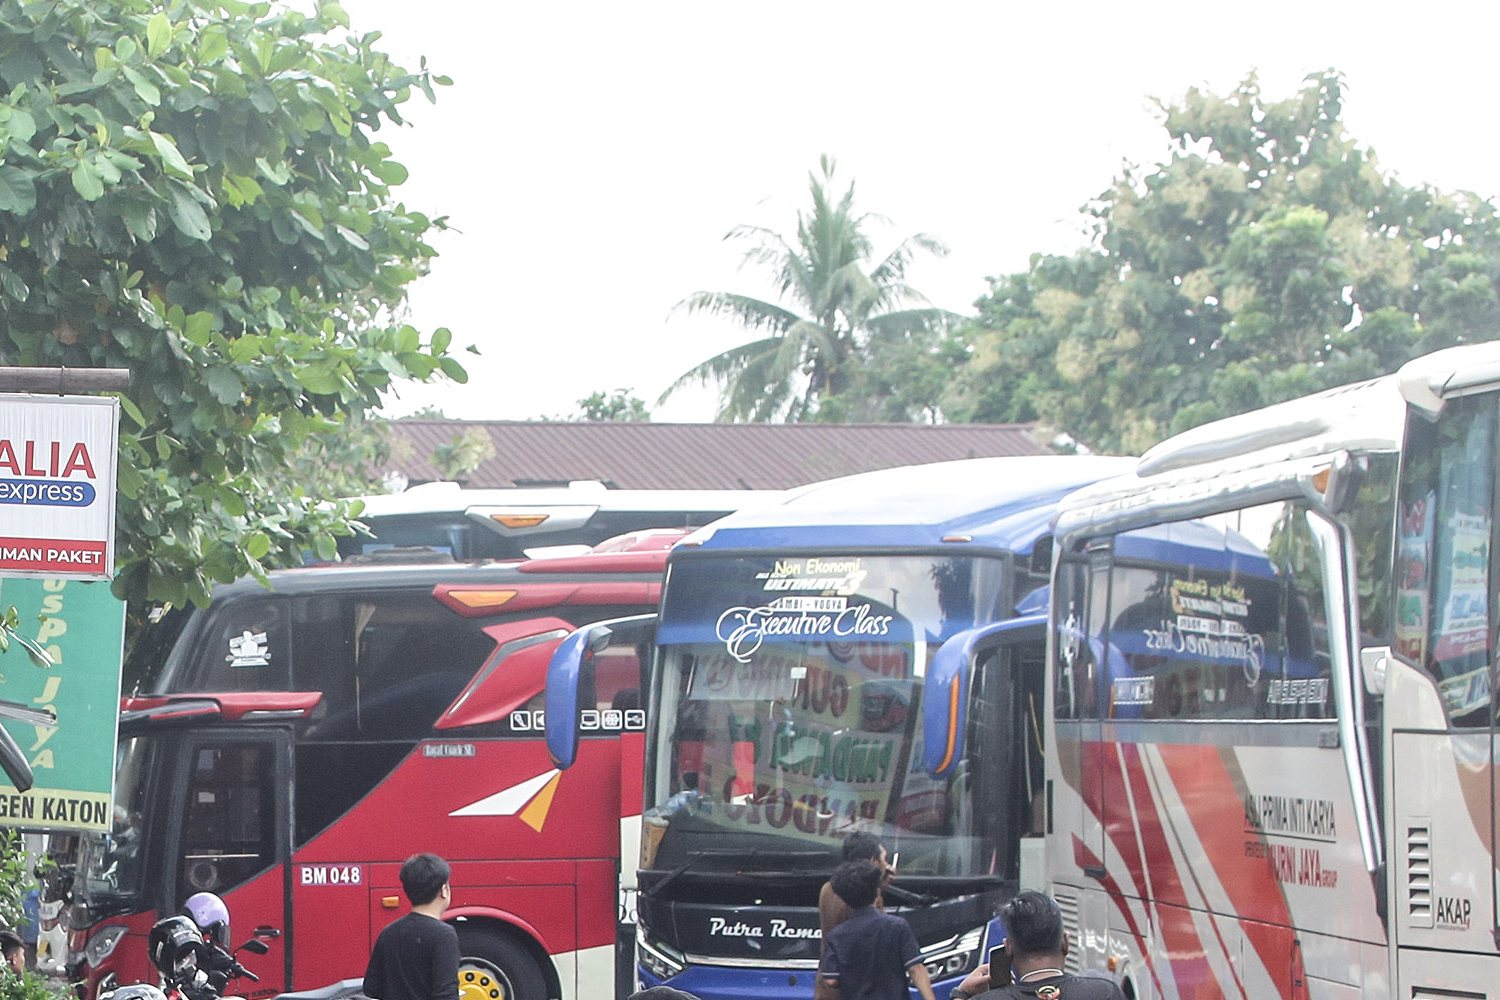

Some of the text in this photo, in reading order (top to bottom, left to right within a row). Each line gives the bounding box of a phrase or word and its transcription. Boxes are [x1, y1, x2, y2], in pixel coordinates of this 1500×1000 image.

[47, 548, 103, 565] PAKET
[775, 557, 861, 575] Non Ekonomi
[774, 599, 804, 611] AMBI
[716, 606, 832, 664] Executive
[833, 604, 893, 637] Class
[42, 797, 107, 825] KATON
[1306, 800, 1337, 837] KARYA
[301, 866, 361, 885] BM 048
[1299, 848, 1323, 888] JAYA
[1437, 897, 1471, 925] AKAP
[709, 917, 764, 937] Putra
